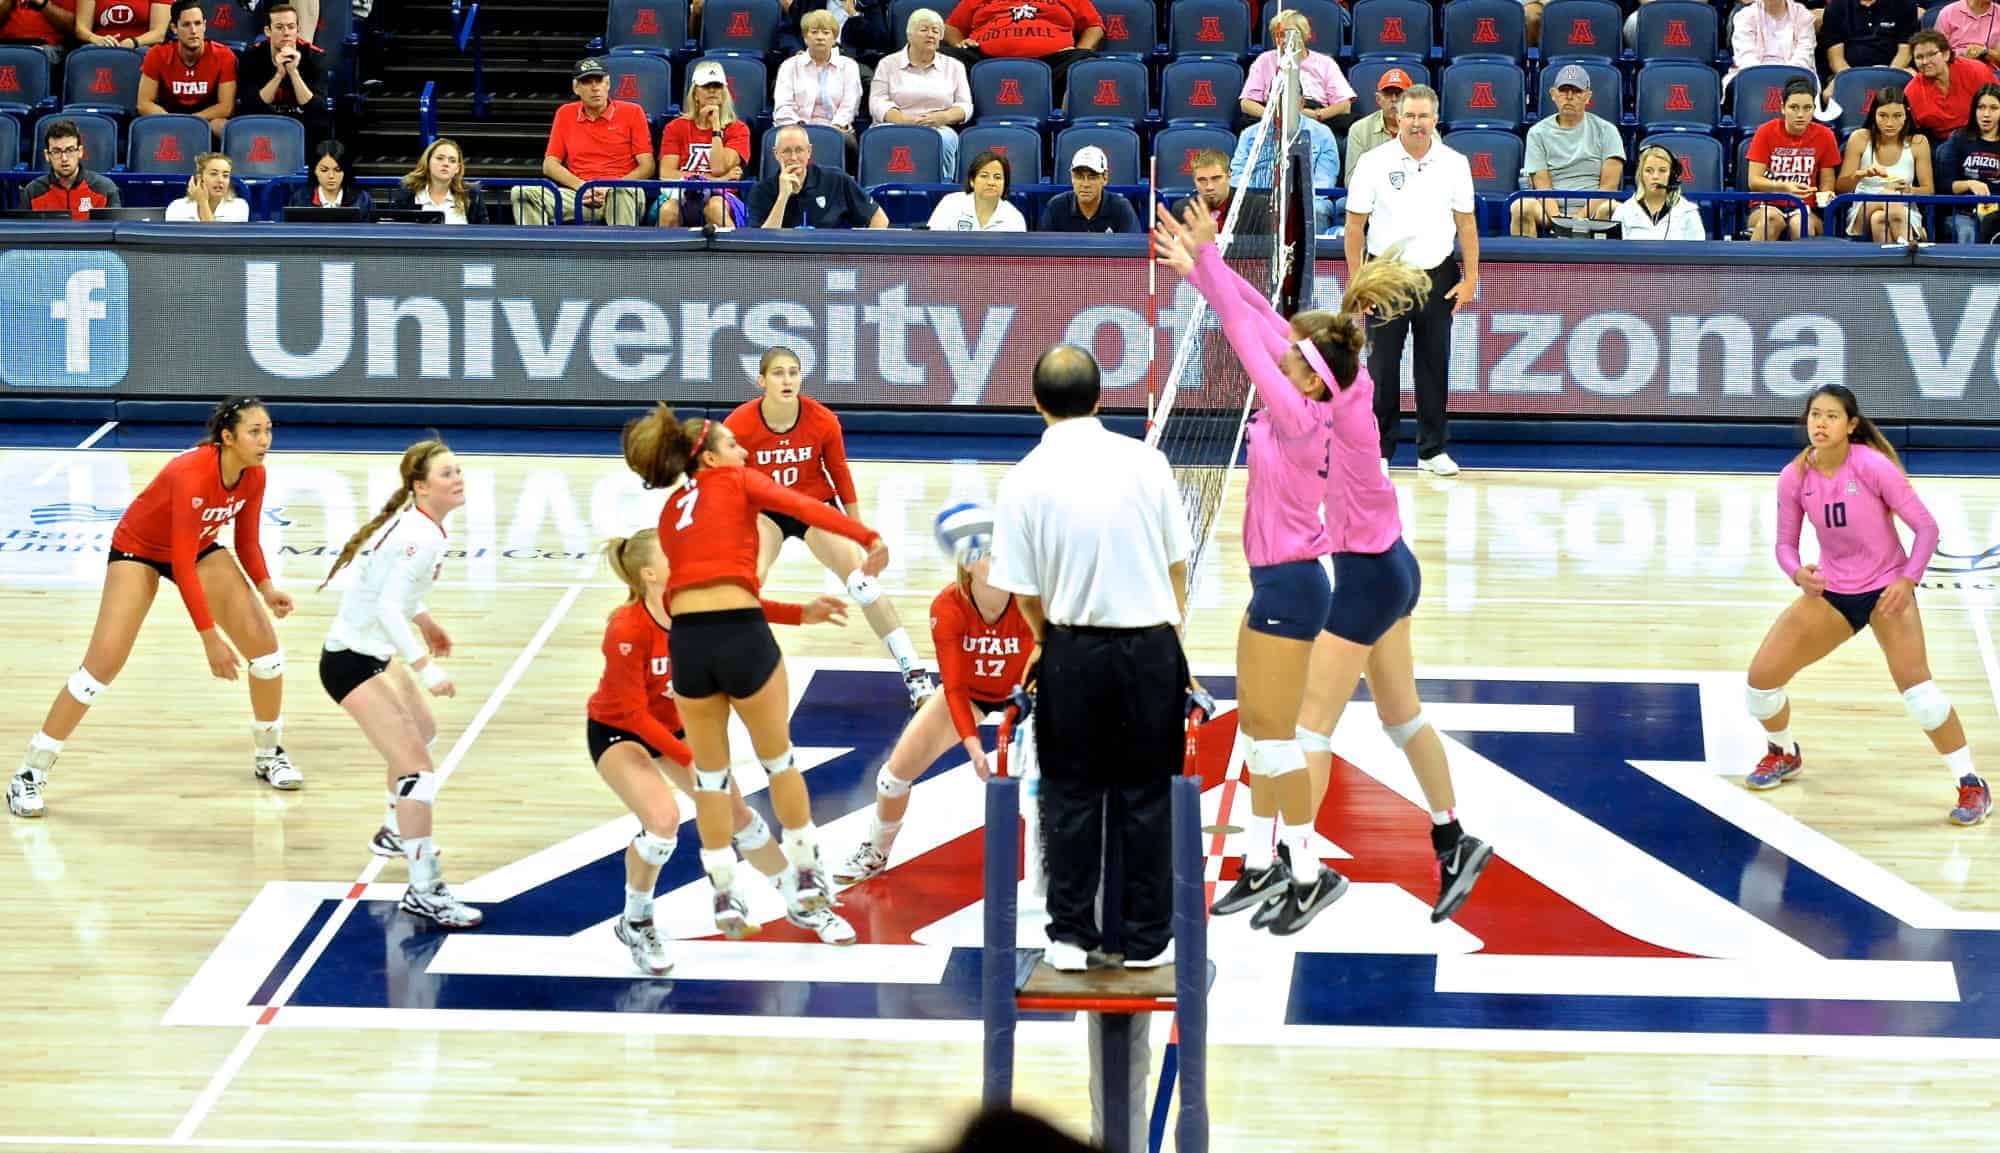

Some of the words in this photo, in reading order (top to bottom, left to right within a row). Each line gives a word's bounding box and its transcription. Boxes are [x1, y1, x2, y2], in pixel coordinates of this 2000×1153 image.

[172, 81, 209, 95] UTAH
[50, 269, 107, 374] f
[243, 260, 1016, 406] University
[1881, 280, 2000, 401] V
[756, 446, 813, 465] UTAH
[771, 467, 799, 488] 10
[201, 499, 246, 522] UTAH
[675, 487, 700, 531] 7
[1824, 501, 1848, 529] 10
[962, 635, 1021, 655] UTAH
[975, 658, 1007, 677] 17
